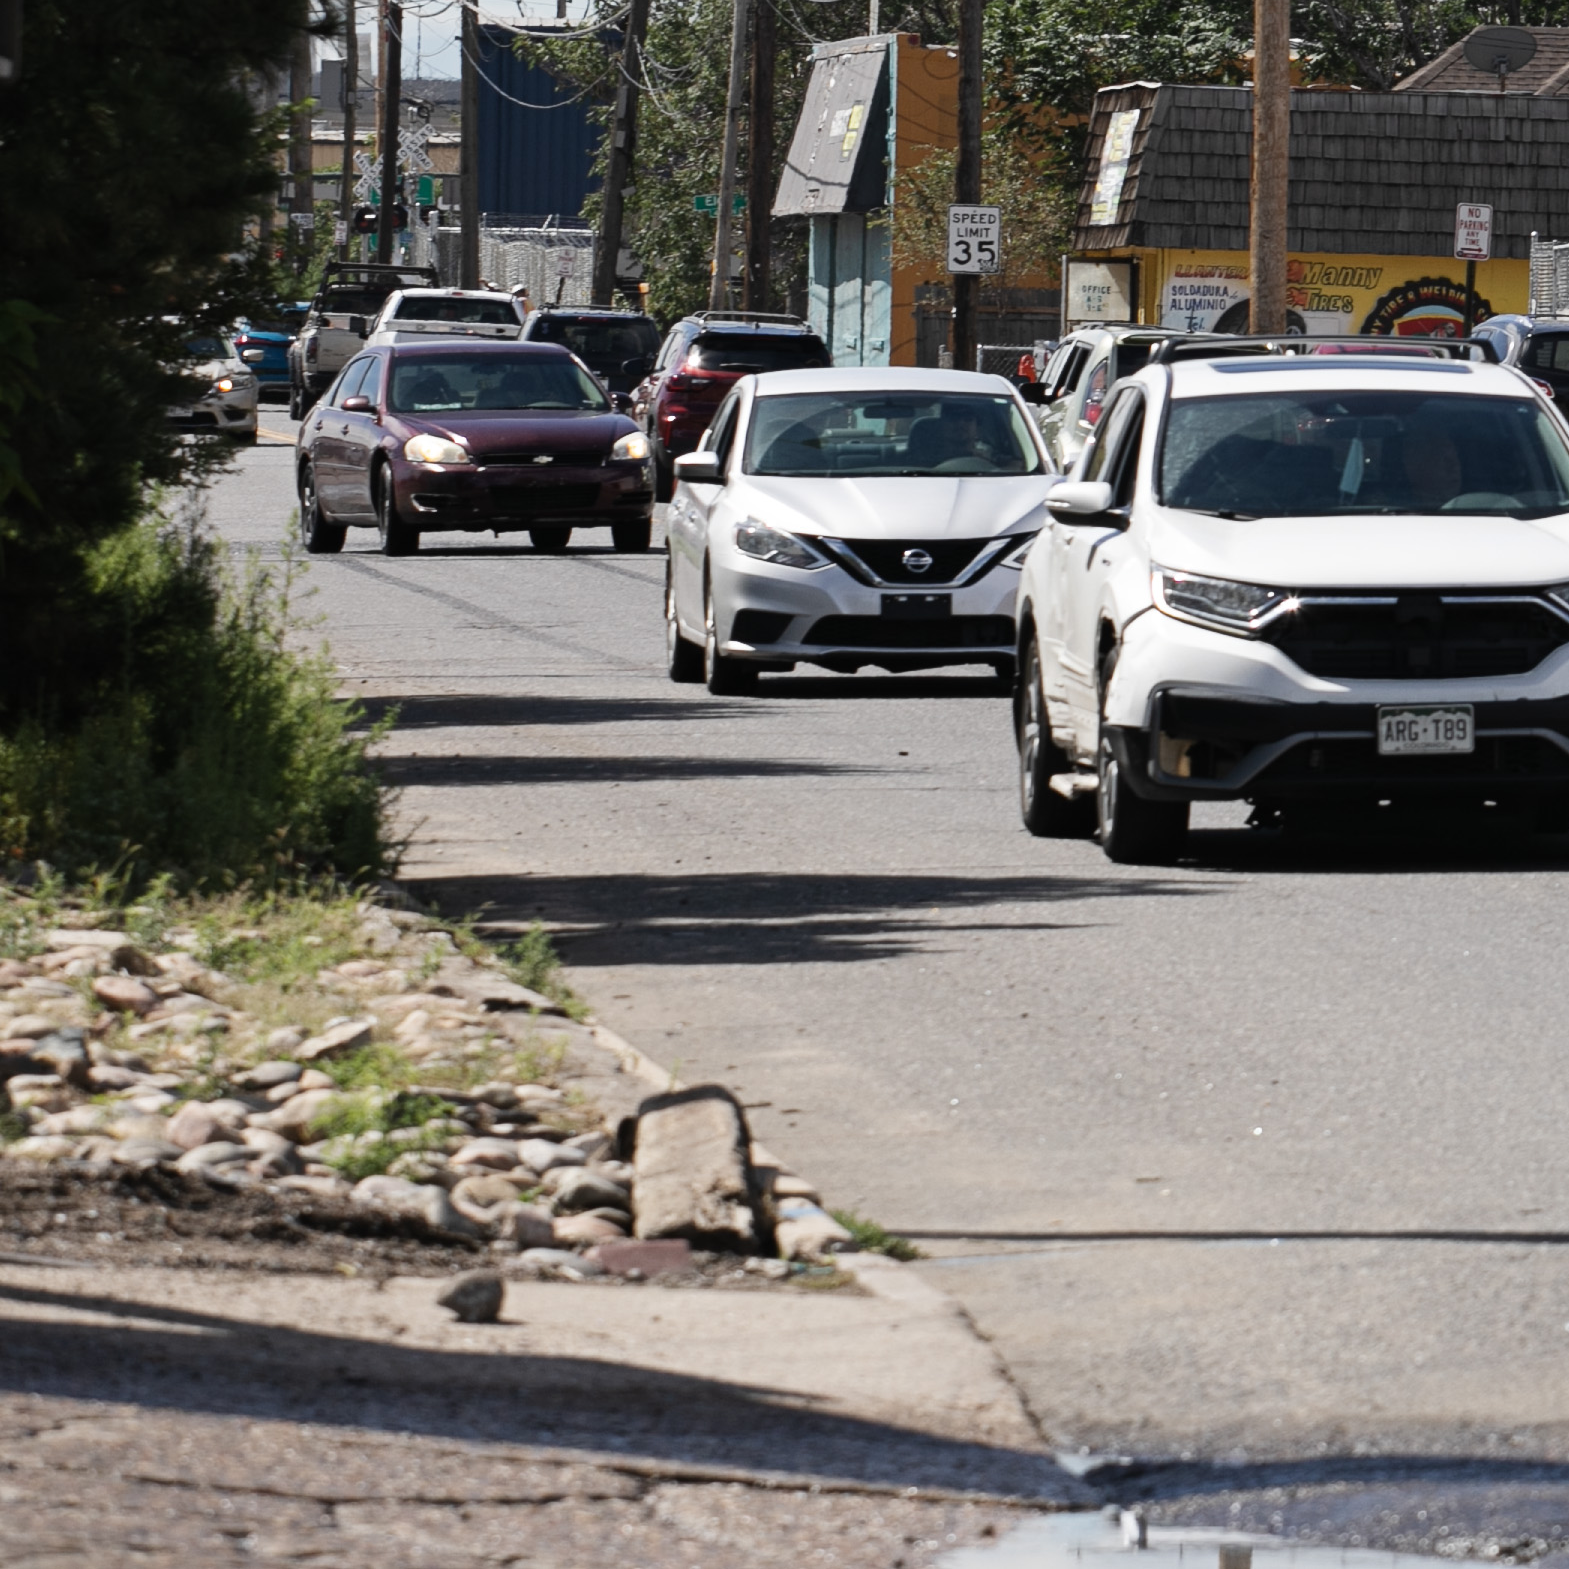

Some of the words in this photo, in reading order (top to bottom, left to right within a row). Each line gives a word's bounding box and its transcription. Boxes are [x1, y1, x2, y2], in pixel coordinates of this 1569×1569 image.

[952, 213, 997, 224] SPEED
[1468, 207, 1481, 218] NO
[1460, 219, 1489, 231] PARKING
[957, 227, 991, 238] LIMIT
[1465, 238, 1480, 246] TIME
[952, 240, 996, 266] 35
[1301, 261, 1383, 290] Manny
[1082, 285, 1111, 295] OFFICE
[1171, 285, 1229, 297] SOLDADURA
[1419, 285, 1467, 302] WELDIN
[1170, 298, 1226, 311] ALUMINIO
